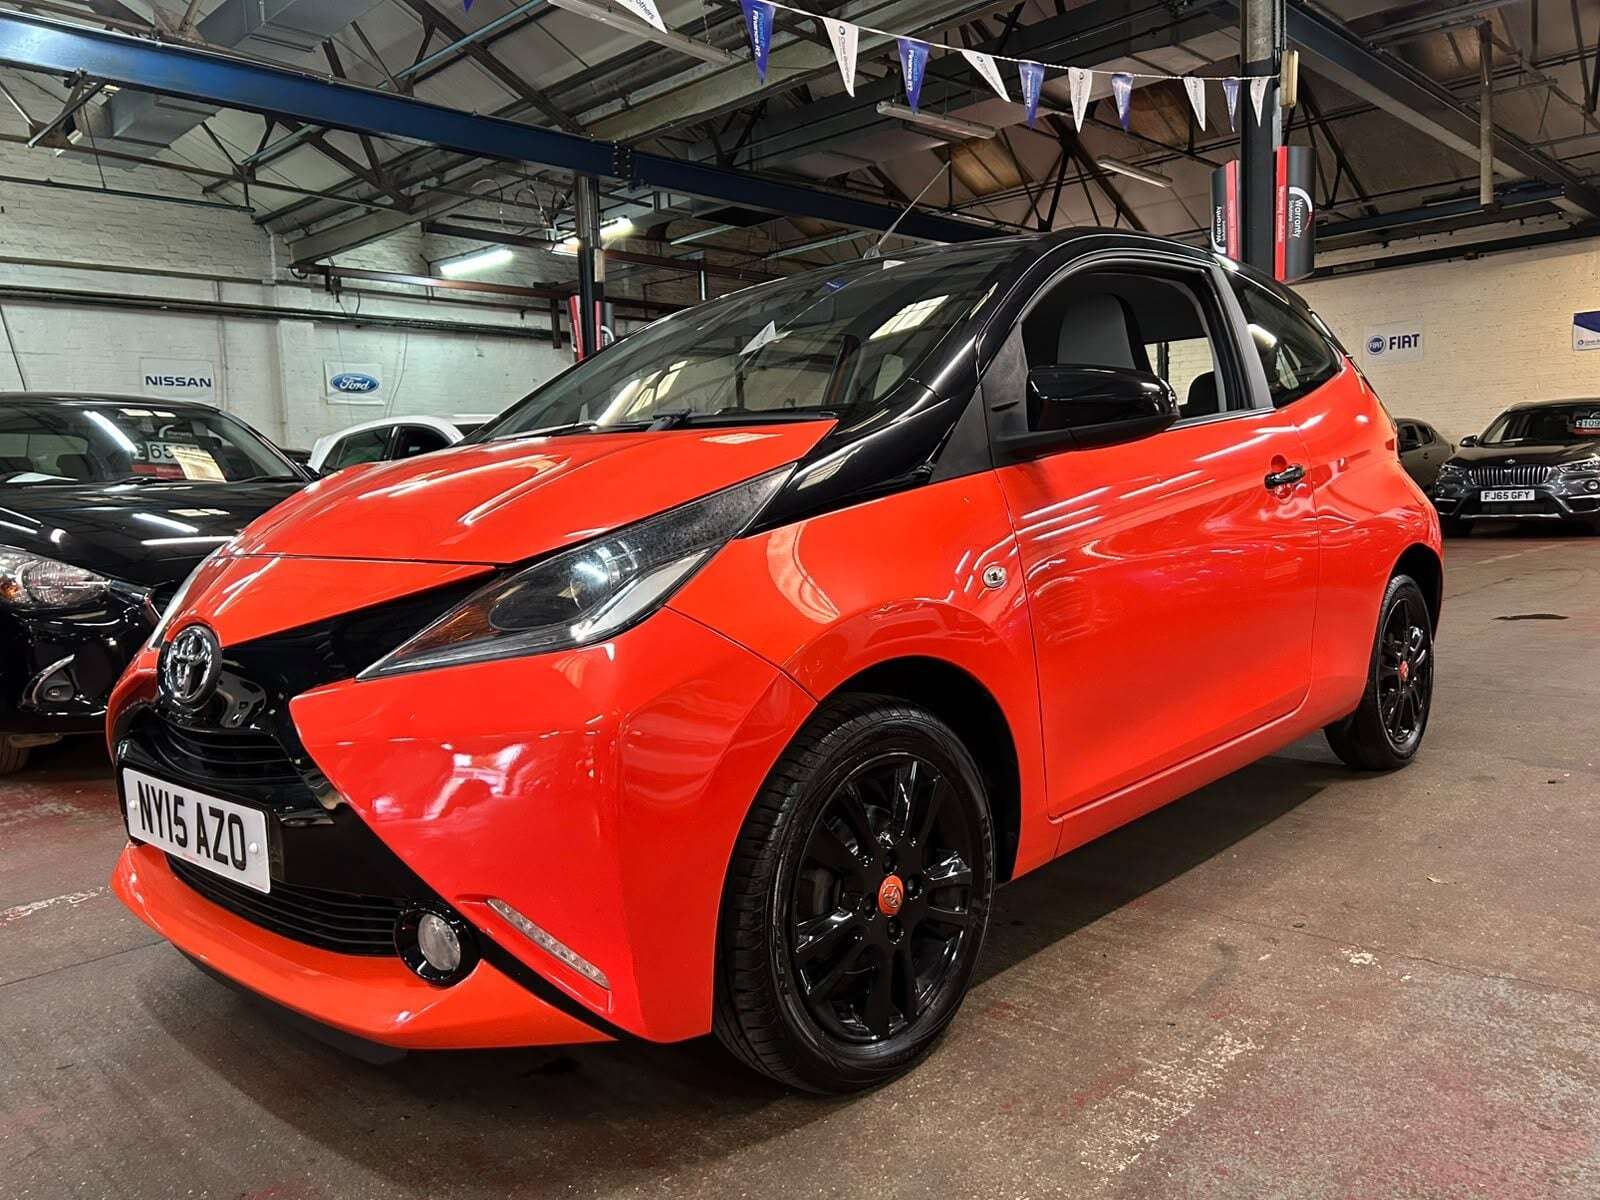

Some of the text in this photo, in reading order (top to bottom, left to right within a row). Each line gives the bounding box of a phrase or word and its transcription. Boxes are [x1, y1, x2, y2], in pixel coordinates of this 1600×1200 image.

[752, 10, 760, 44] Finance
[1215, 206, 1223, 243] Warranty
[1293, 198, 1303, 239] Warranty
[1369, 341, 1383, 349] FIAT
[1389, 333, 1420, 350] FIAT
[145, 375, 212, 388] NISSAN
[339, 375, 370, 390] Ford
[1484, 491, 1530, 501] FJ65 GFY
[137, 781, 247, 871] NY15 AZO
